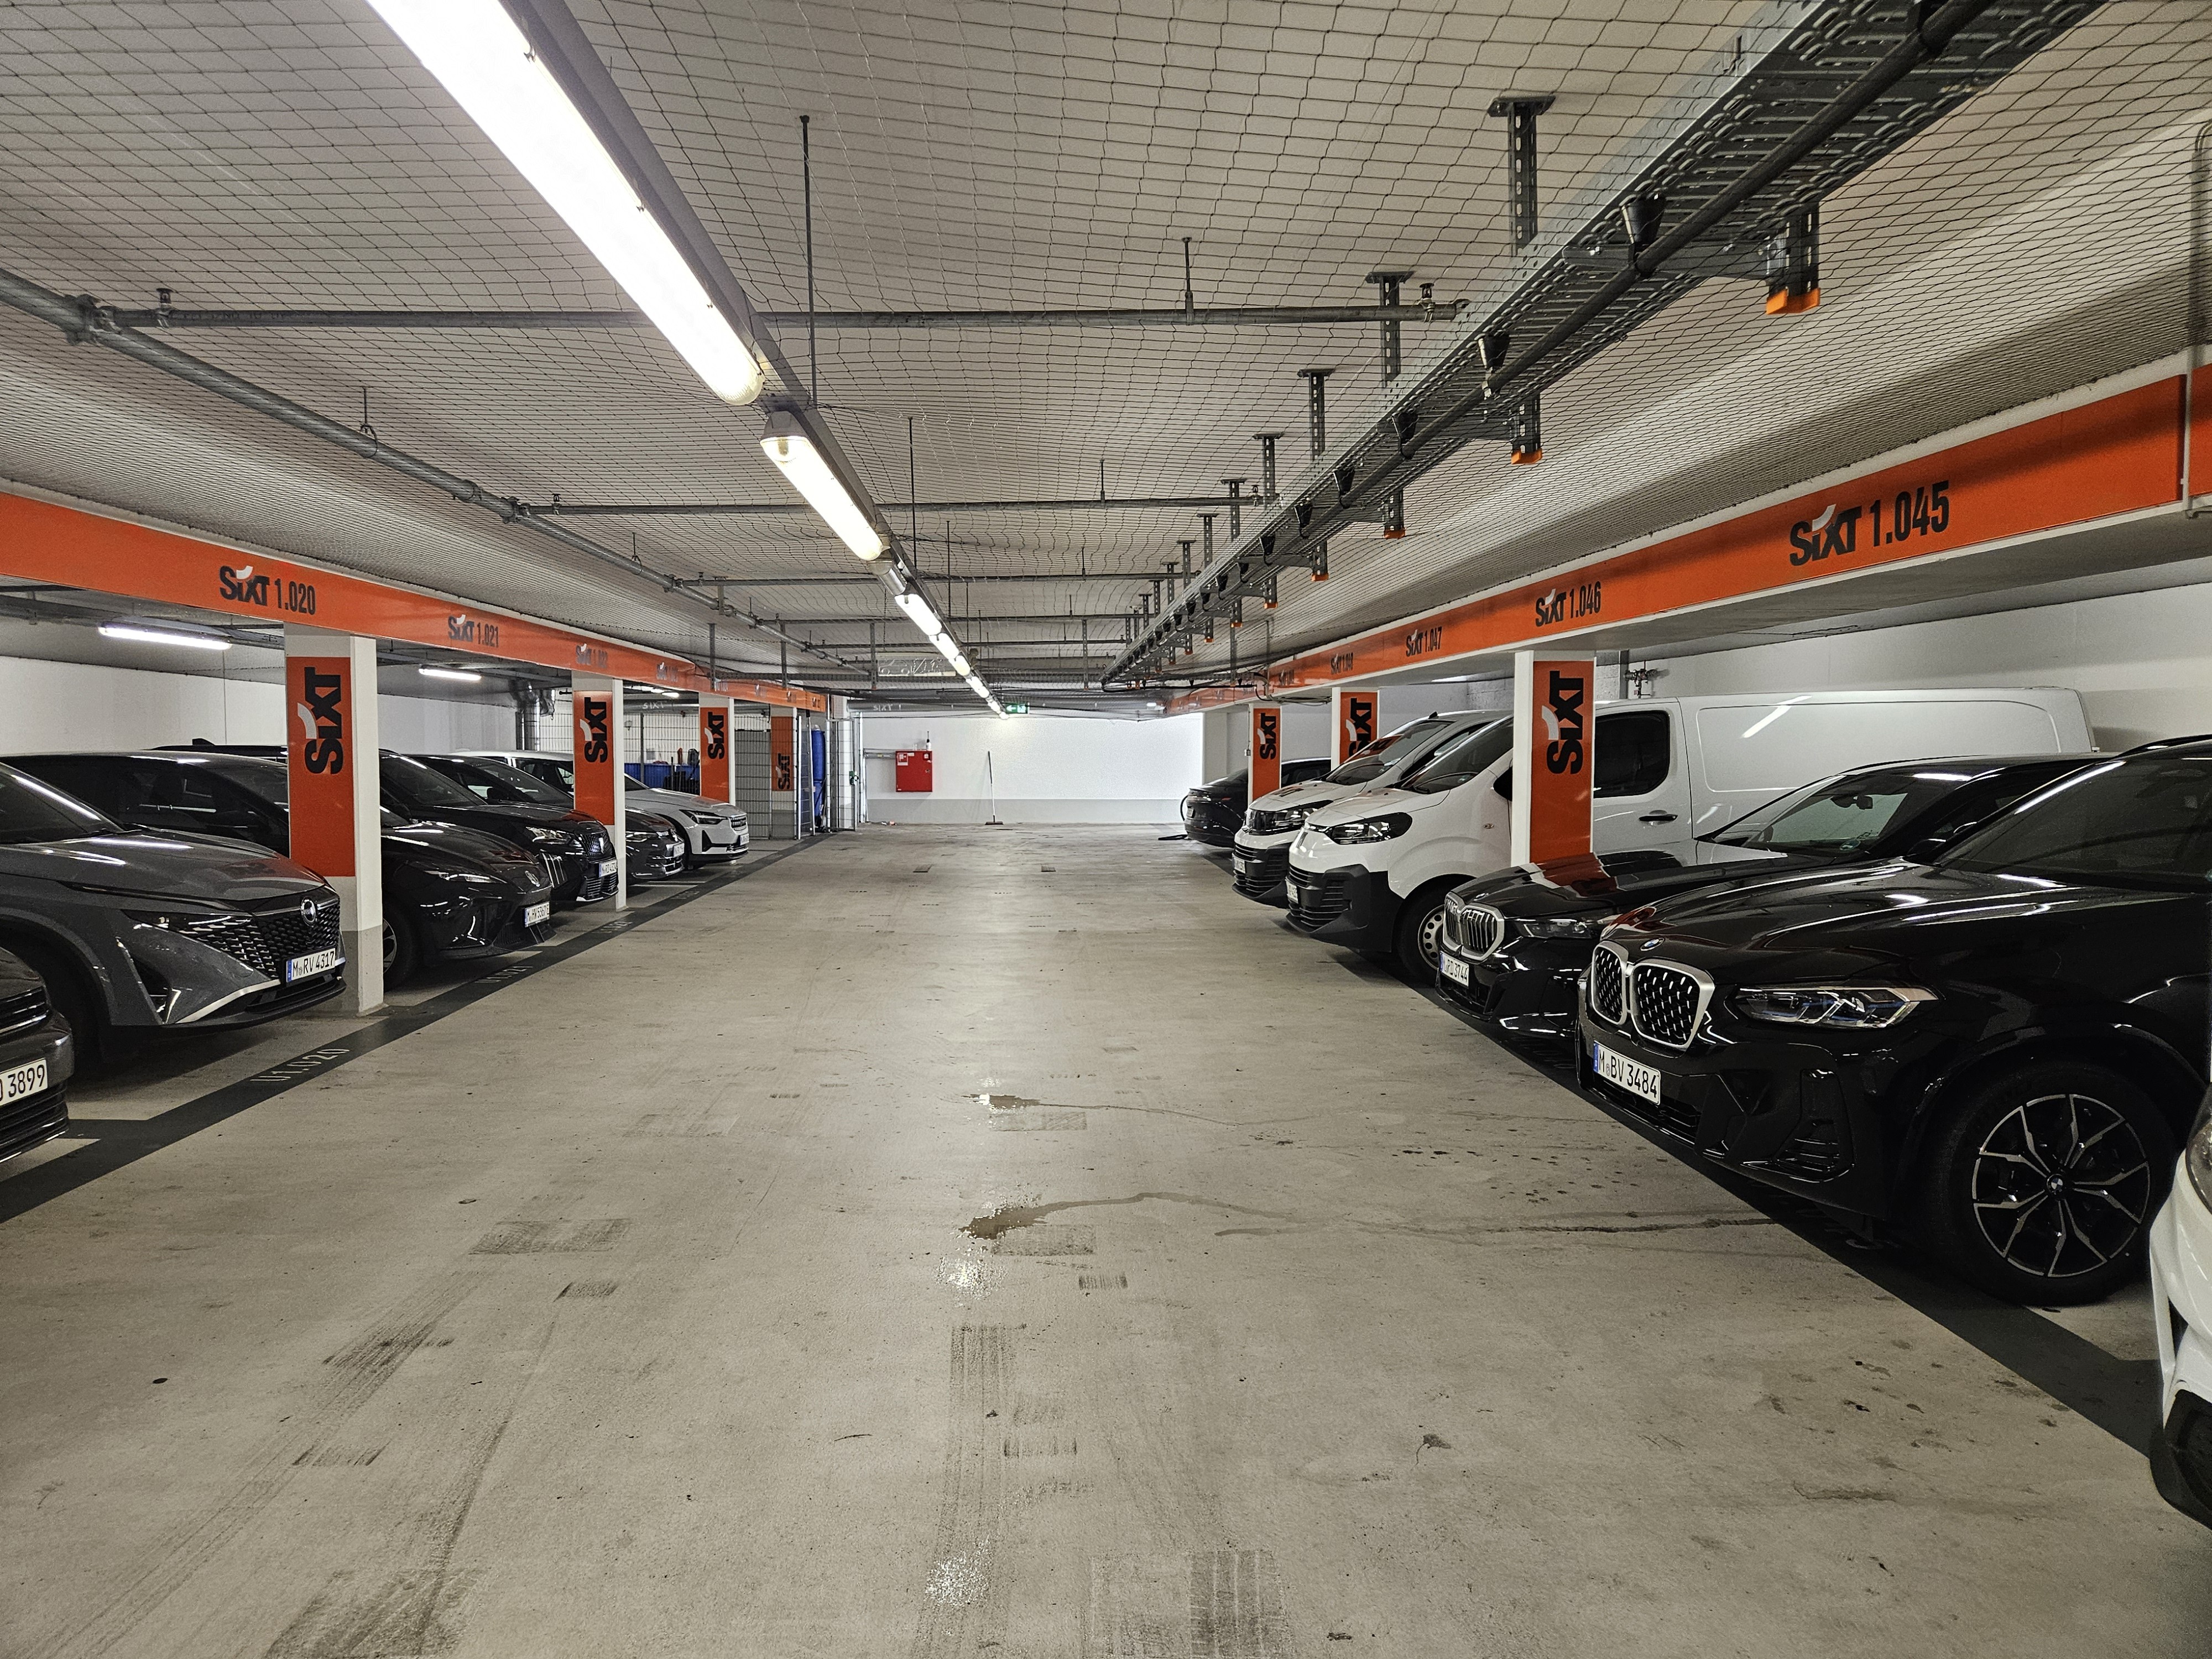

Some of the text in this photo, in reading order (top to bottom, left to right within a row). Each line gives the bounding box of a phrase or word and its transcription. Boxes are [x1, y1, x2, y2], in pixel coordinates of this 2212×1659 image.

[1870, 480, 1949, 547] 1.045
[274, 578, 316, 615] 1.020
[1569, 581, 1601, 619] 1.046
[477, 622, 499, 648] 1.021
[1425, 626, 1442, 653] 1.047
[315, 951, 335, 970] 4317
[1454, 963, 1468, 983] 3744
[8, 1065, 45, 1098] 3899
[1627, 1063, 1657, 1098] 3484
